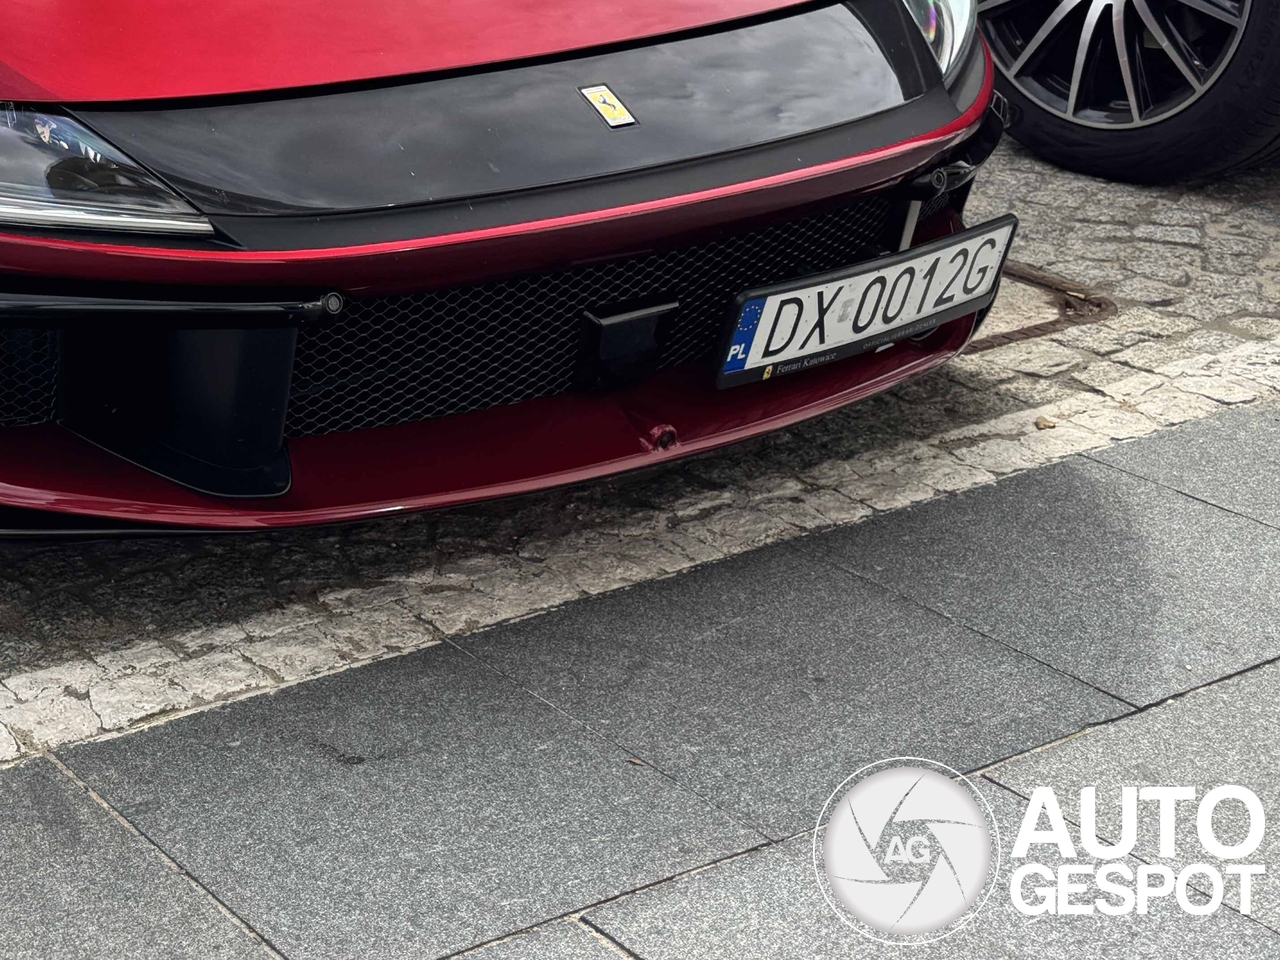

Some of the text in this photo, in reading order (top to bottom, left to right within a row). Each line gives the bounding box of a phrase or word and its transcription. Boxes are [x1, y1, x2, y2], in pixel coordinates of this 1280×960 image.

[761, 238, 997, 359] DX 0012G
[727, 343, 746, 361] PL
[777, 352, 837, 374] Ferrari Katowice
